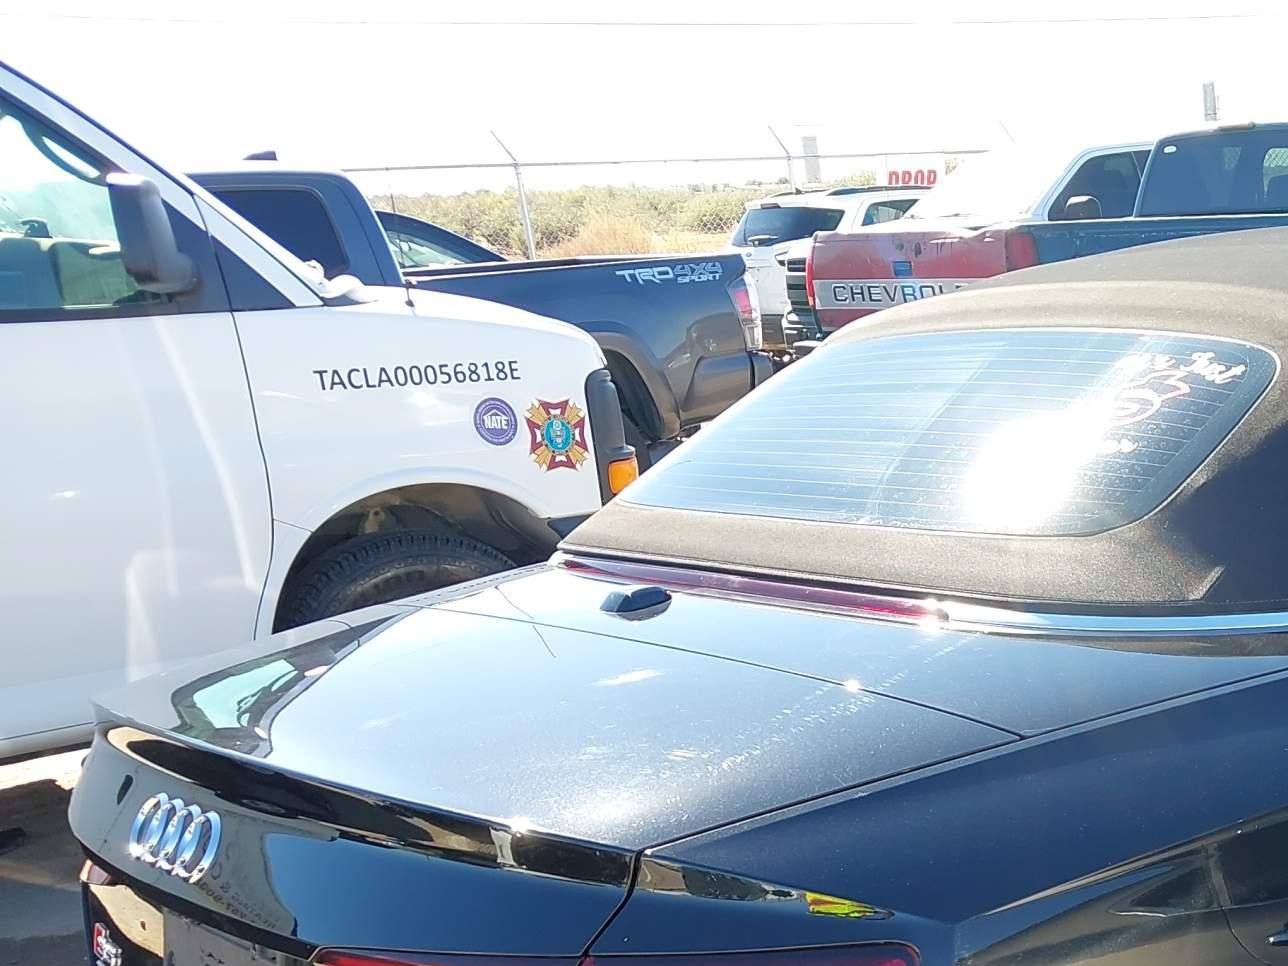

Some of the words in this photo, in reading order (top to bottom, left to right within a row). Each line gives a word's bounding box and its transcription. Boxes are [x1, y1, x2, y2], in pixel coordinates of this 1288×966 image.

[616, 266, 674, 285] TRD
[677, 273, 722, 284] SPORT
[832, 283, 969, 304] CHEVRO
[312, 360, 521, 391] TACLA00056818E
[483, 413, 510, 430] NATE
